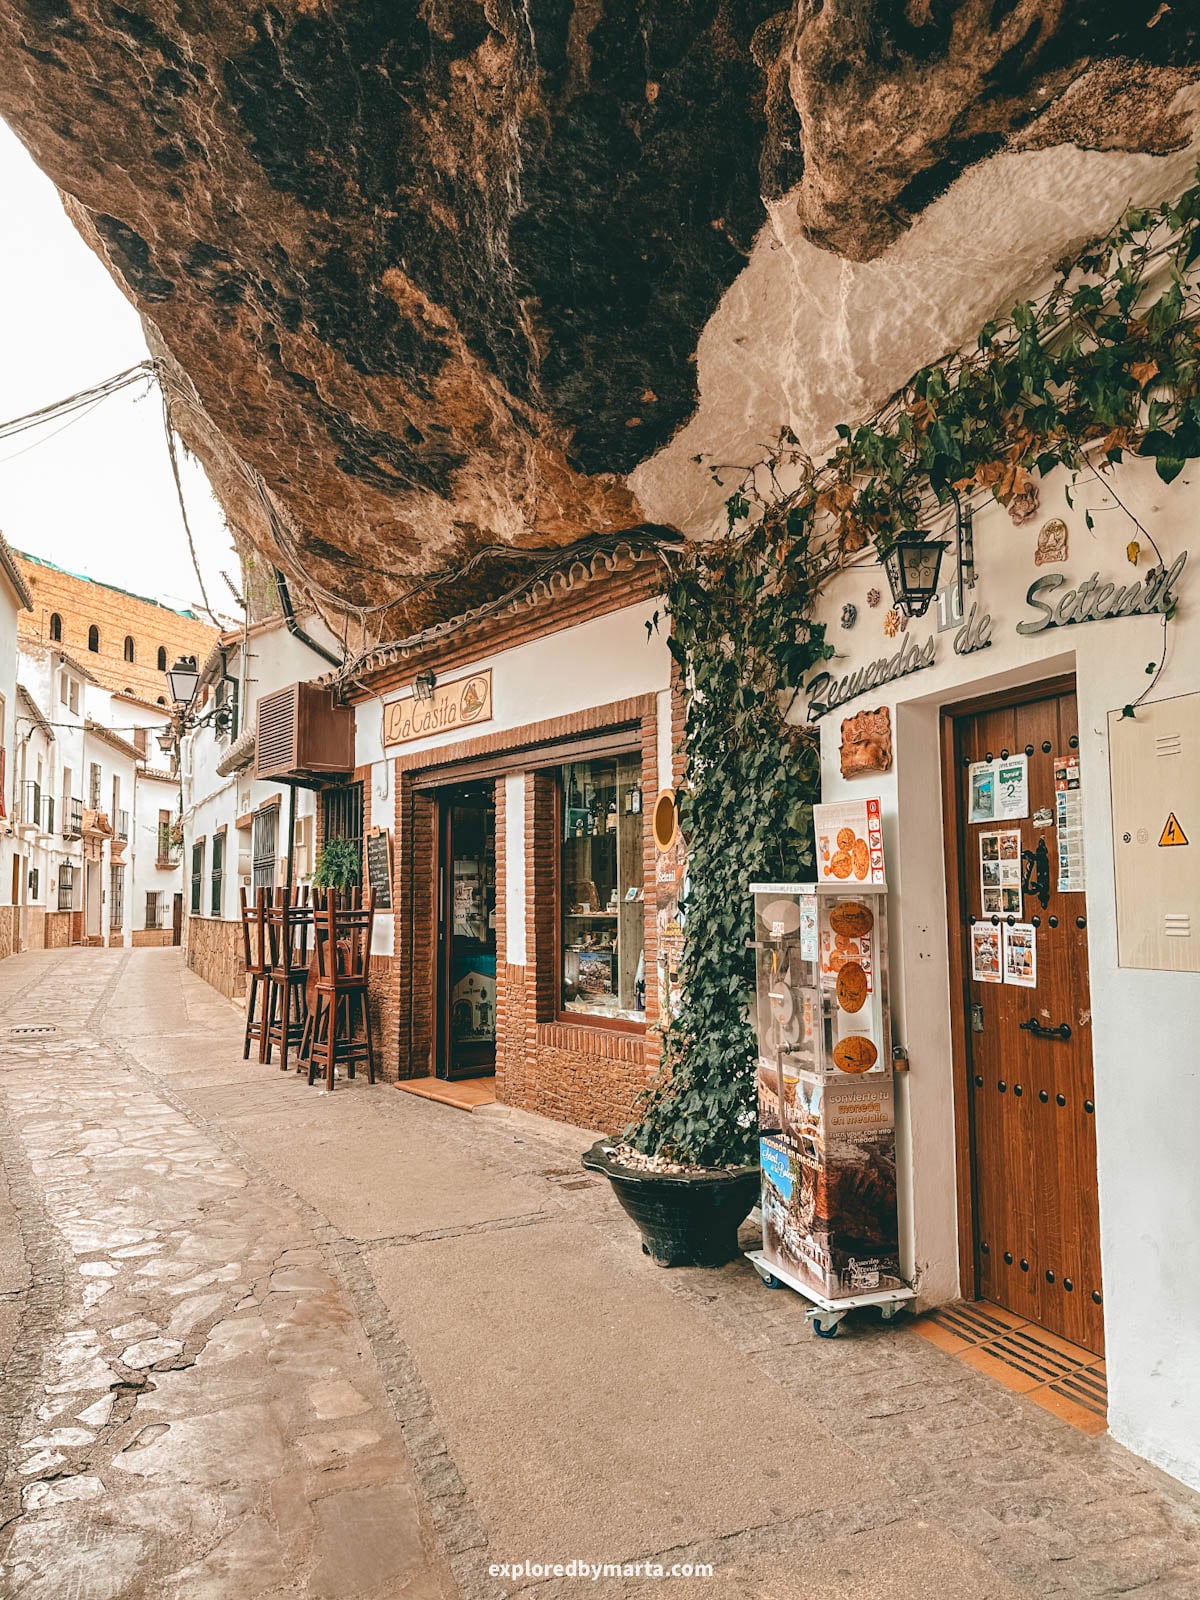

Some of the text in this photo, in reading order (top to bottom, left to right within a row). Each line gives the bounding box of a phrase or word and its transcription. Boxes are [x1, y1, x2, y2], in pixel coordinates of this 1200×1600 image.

[806, 551, 1188, 712] Recuerdos de Setenil
